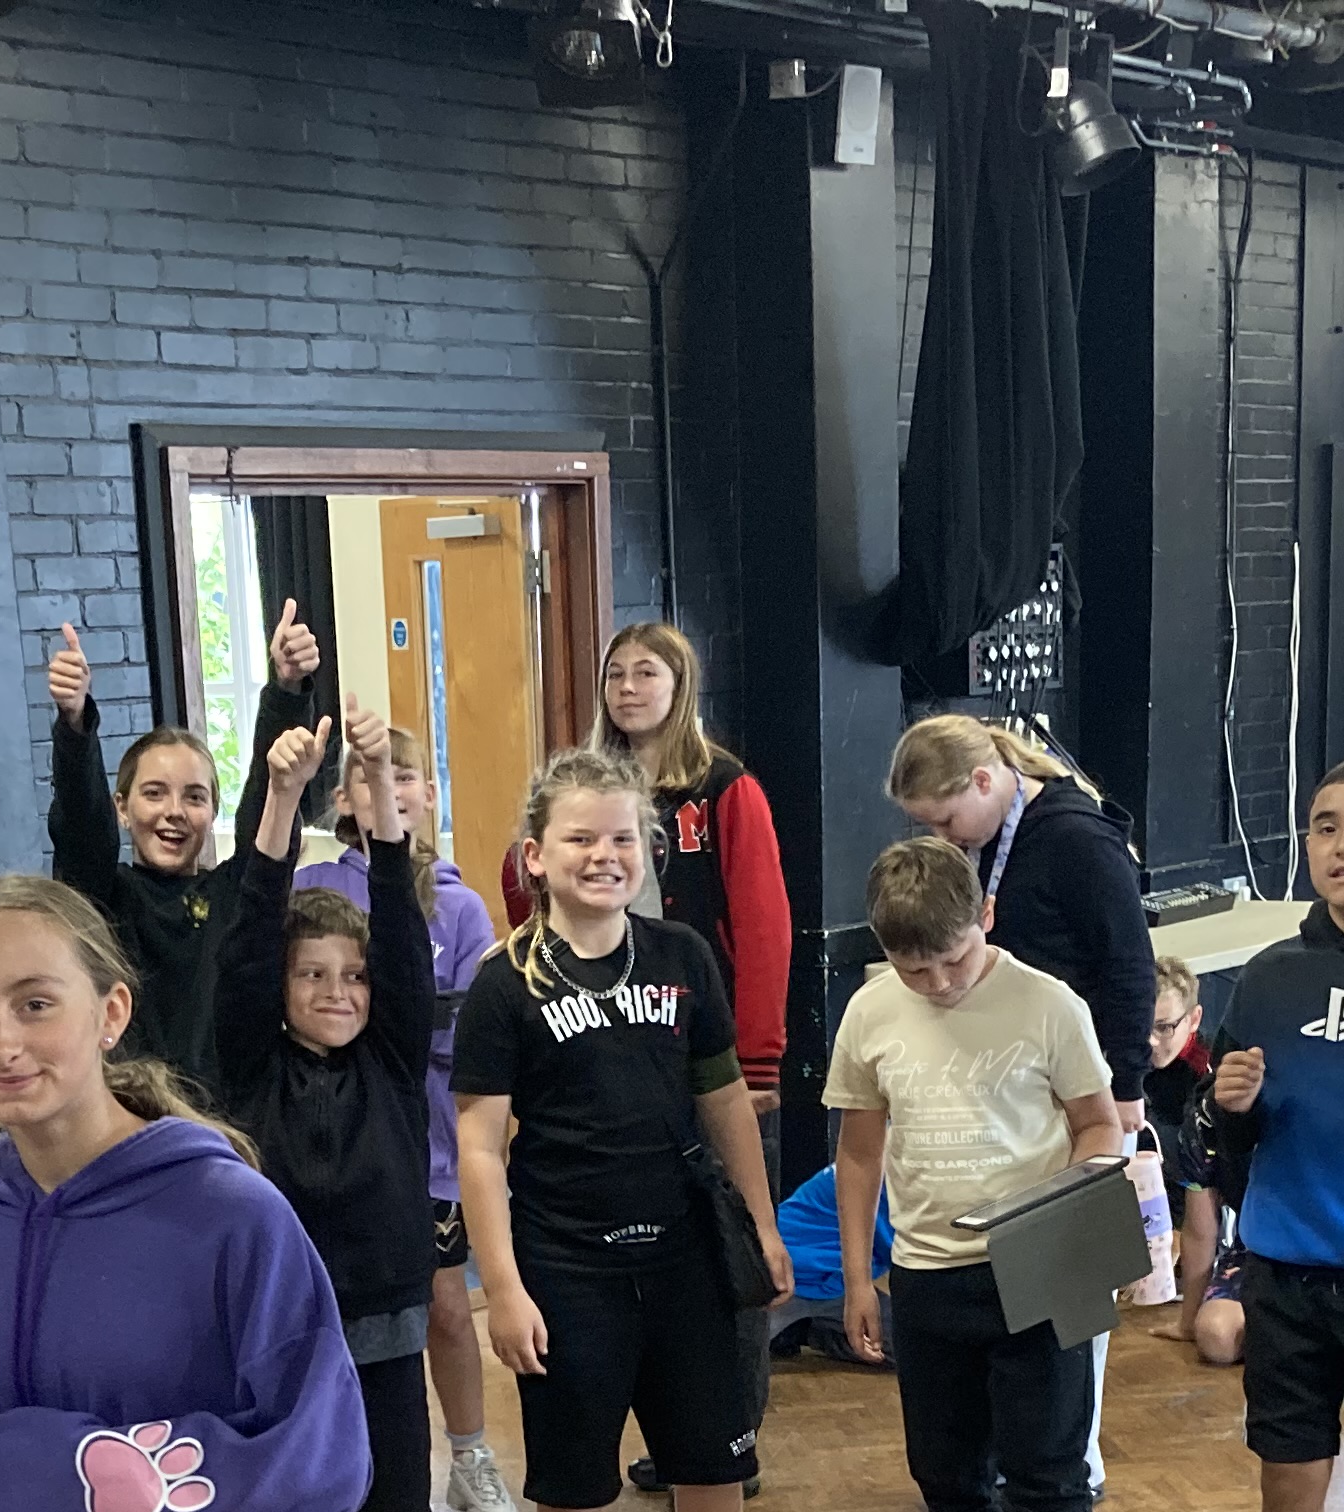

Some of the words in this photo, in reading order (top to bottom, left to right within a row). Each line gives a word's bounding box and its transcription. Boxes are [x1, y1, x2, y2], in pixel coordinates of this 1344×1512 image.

[541, 985, 678, 1043] HOORICH
[897, 1085, 920, 1100] RUE
[924, 1082, 991, 1098] CRÉMEUX
[934, 1129, 998, 1145] COLLECTION
[934, 1155, 1013, 1171] GARÇONS
